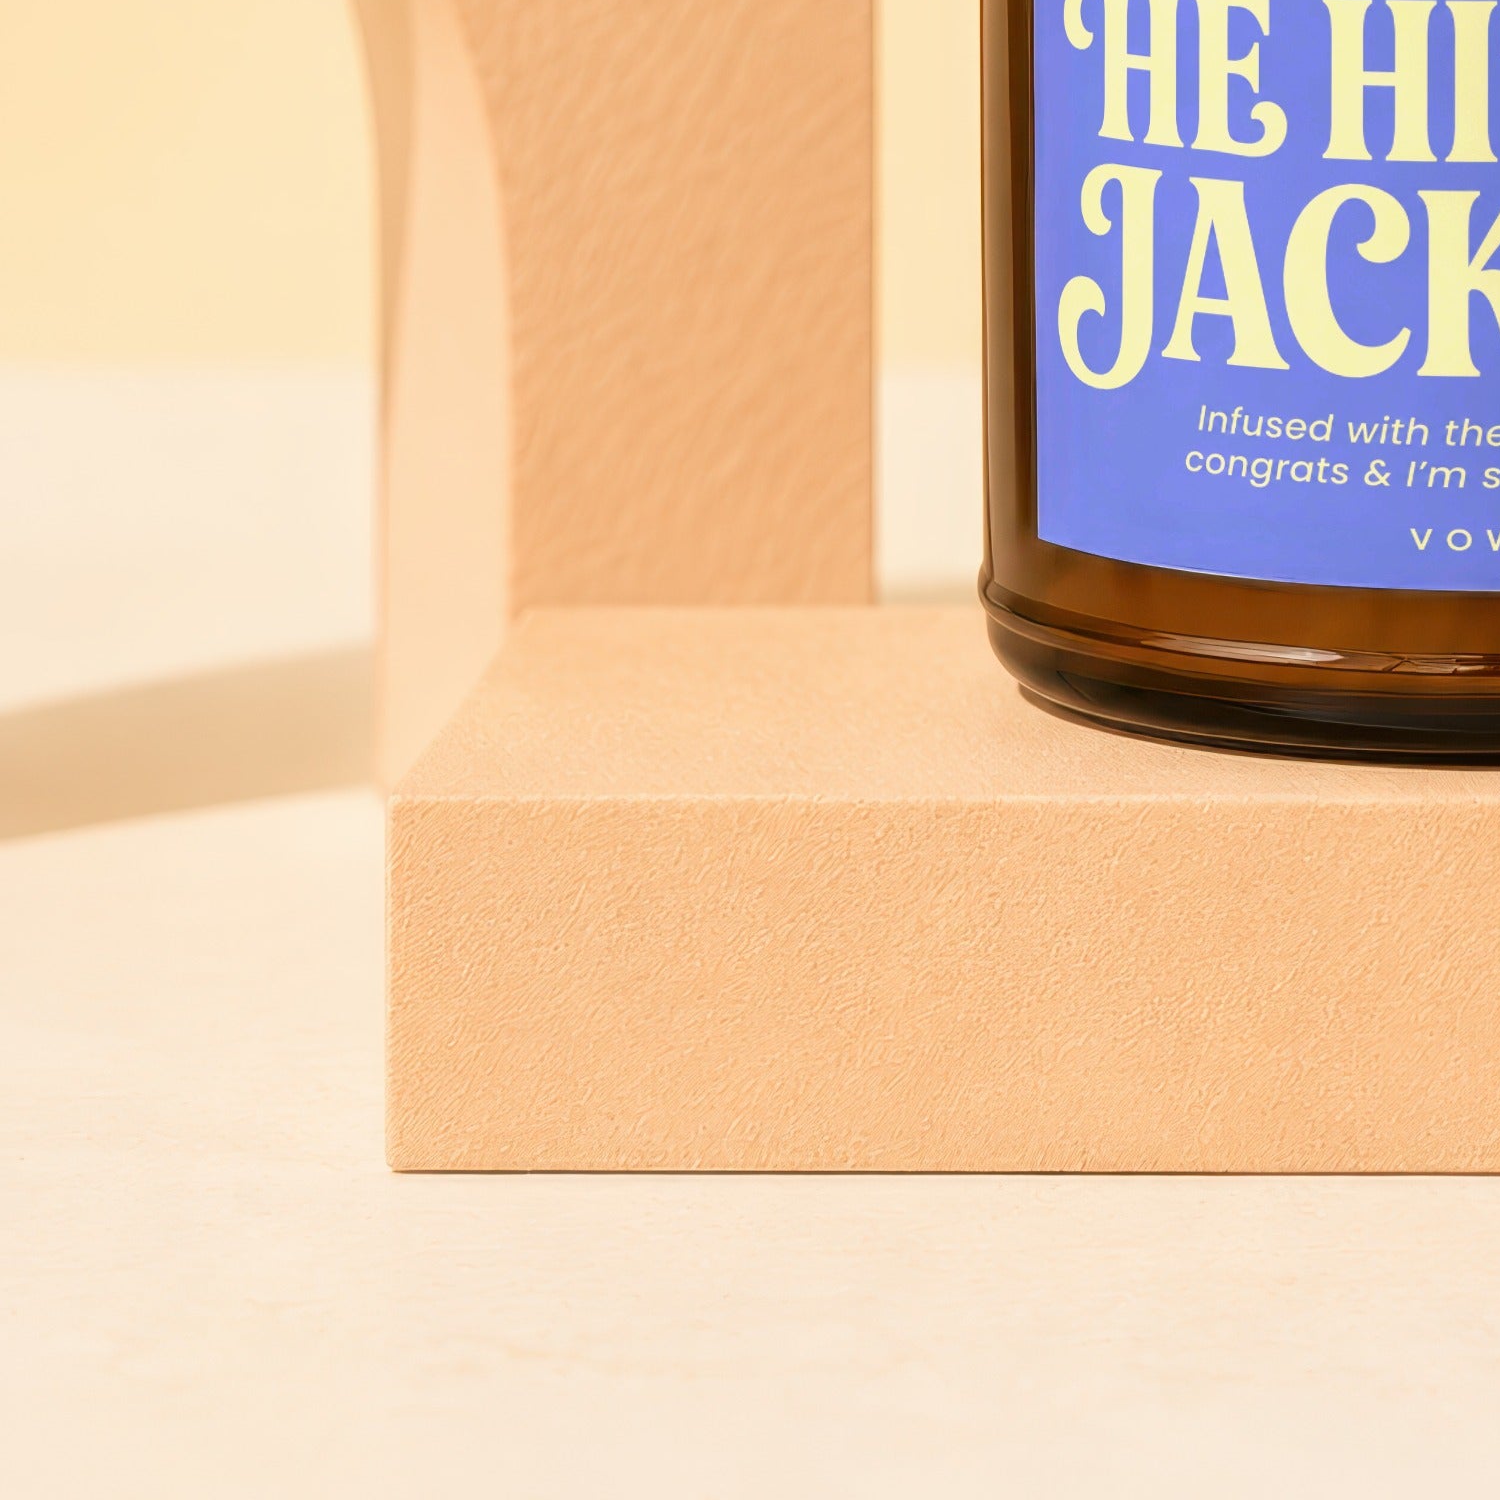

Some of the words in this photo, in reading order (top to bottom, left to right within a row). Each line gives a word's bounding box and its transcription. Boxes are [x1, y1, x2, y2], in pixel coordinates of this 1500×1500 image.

[1197, 403, 1336, 443] Infused
[1346, 414, 1430, 448] with
[1184, 450, 1350, 489] congrats
[1362, 457, 1393, 488] &
